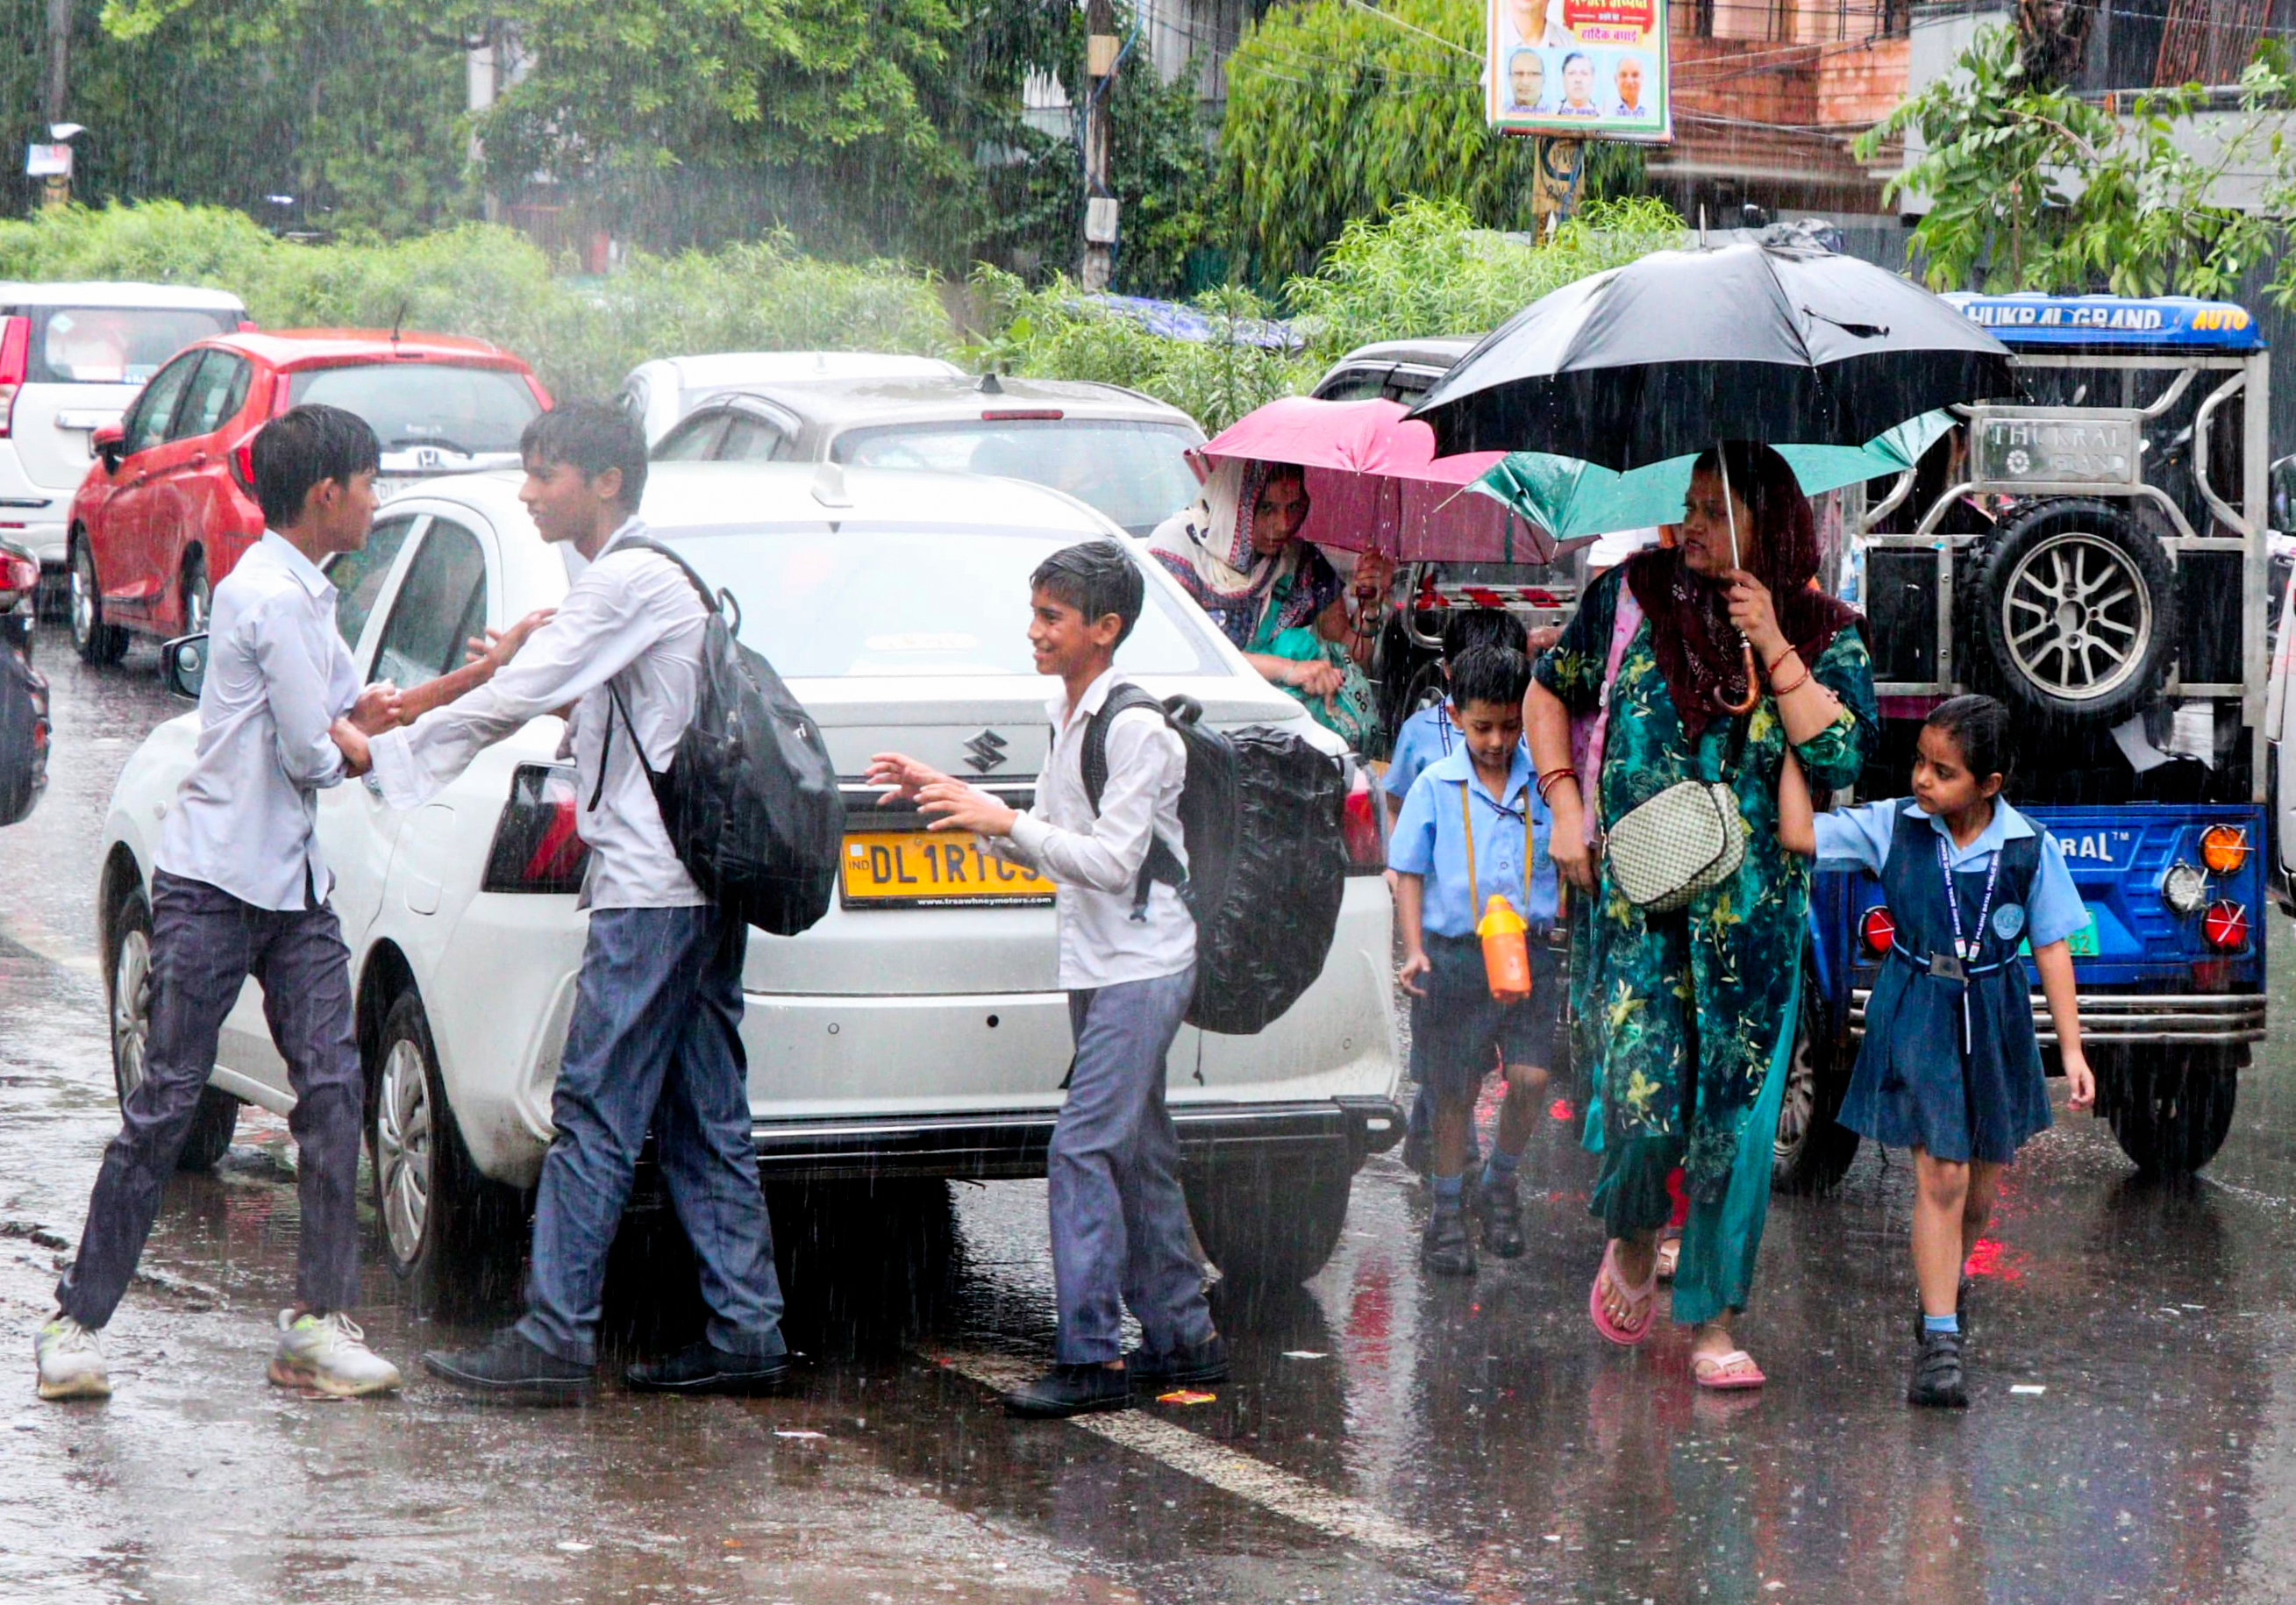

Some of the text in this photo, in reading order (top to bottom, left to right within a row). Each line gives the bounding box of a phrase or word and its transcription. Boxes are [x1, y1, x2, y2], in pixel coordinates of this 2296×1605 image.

[2072, 308, 2162, 329] GRAND
[2191, 309, 2250, 331] AUTO
[848, 860, 870, 871] IND
[1943, 861, 1952, 886] PUBLIC
[1986, 867, 1998, 891] PUBLIC
[917, 896, 1052, 906] www.trsawhneymotors.com
